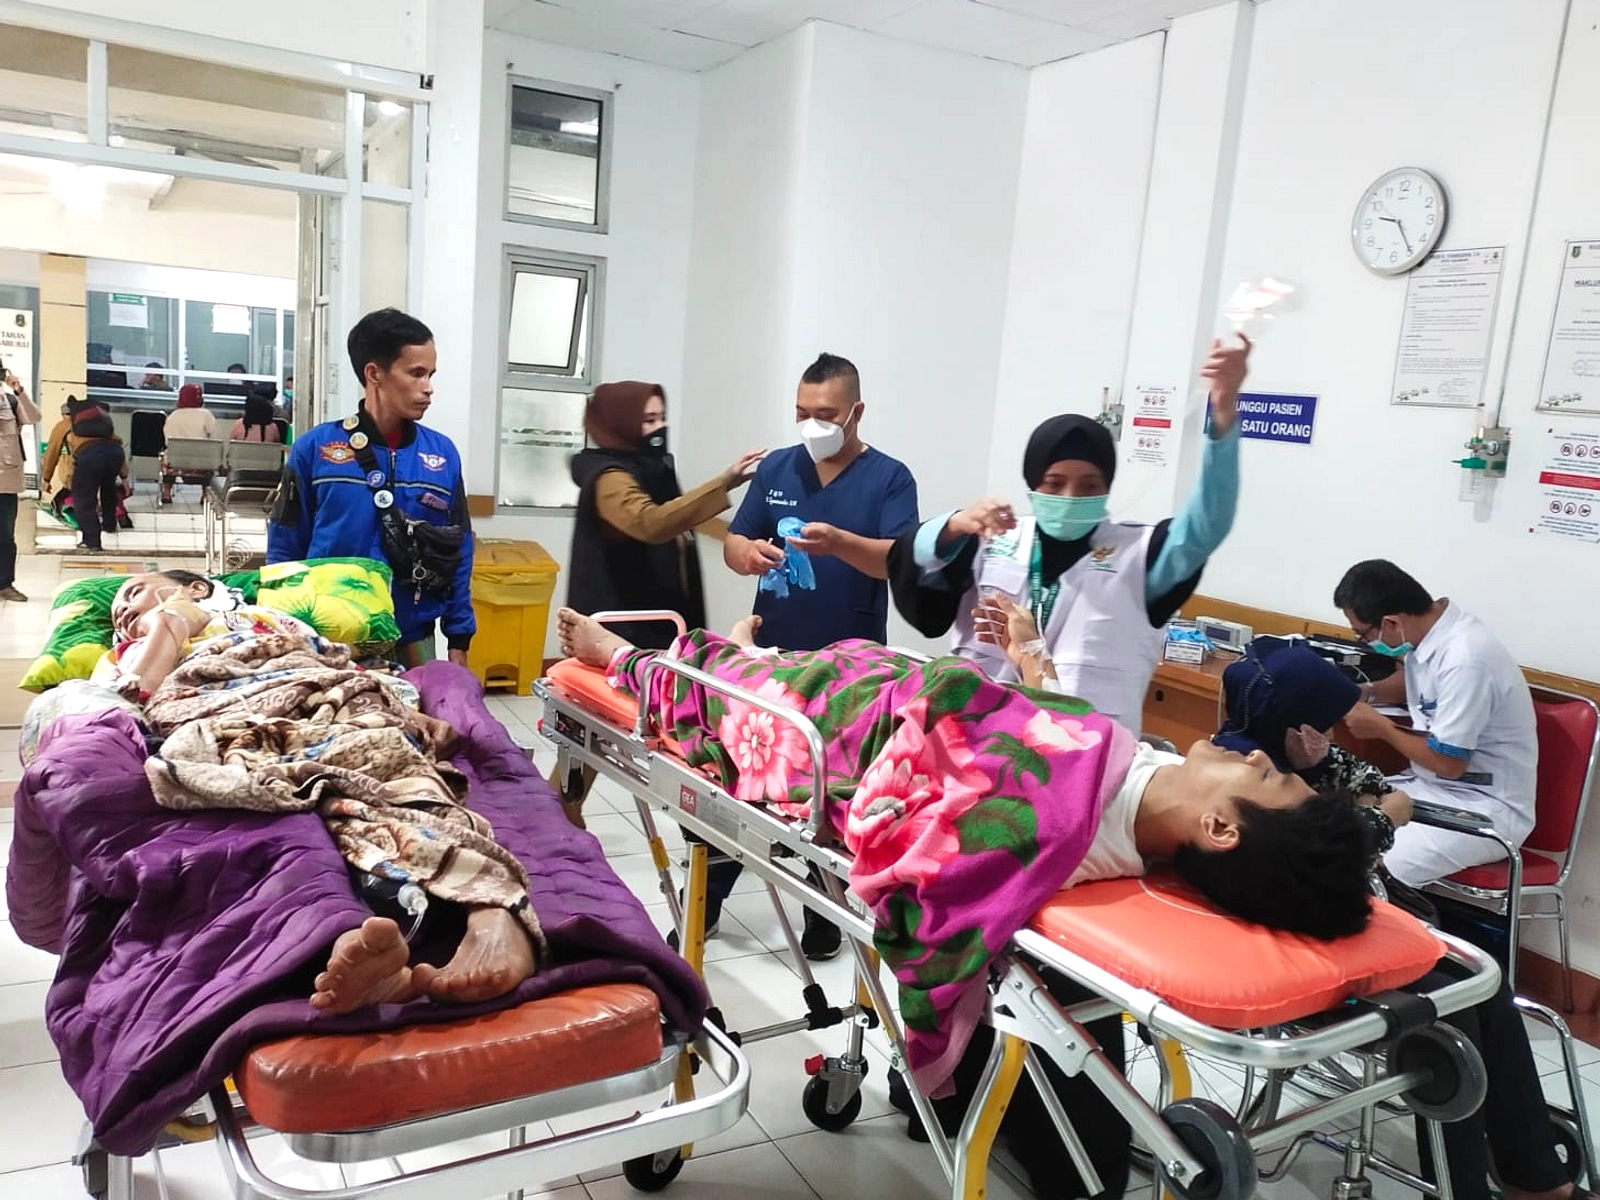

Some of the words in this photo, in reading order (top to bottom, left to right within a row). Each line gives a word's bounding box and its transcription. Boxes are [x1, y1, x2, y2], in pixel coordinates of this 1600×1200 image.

[1400, 180, 1411, 192] 12
[1424, 196, 1434, 208] 2
[1364, 218, 1373, 229] 9
[1425, 213, 1434, 226] 3
[1418, 232, 1427, 242] 4
[1389, 250, 1399, 262] 6
[1235, 400, 1268, 414] UNGGU
[1268, 402, 1303, 416] PASIEN
[1241, 419, 1269, 434] SATU
[1271, 422, 1311, 437] ORANG
